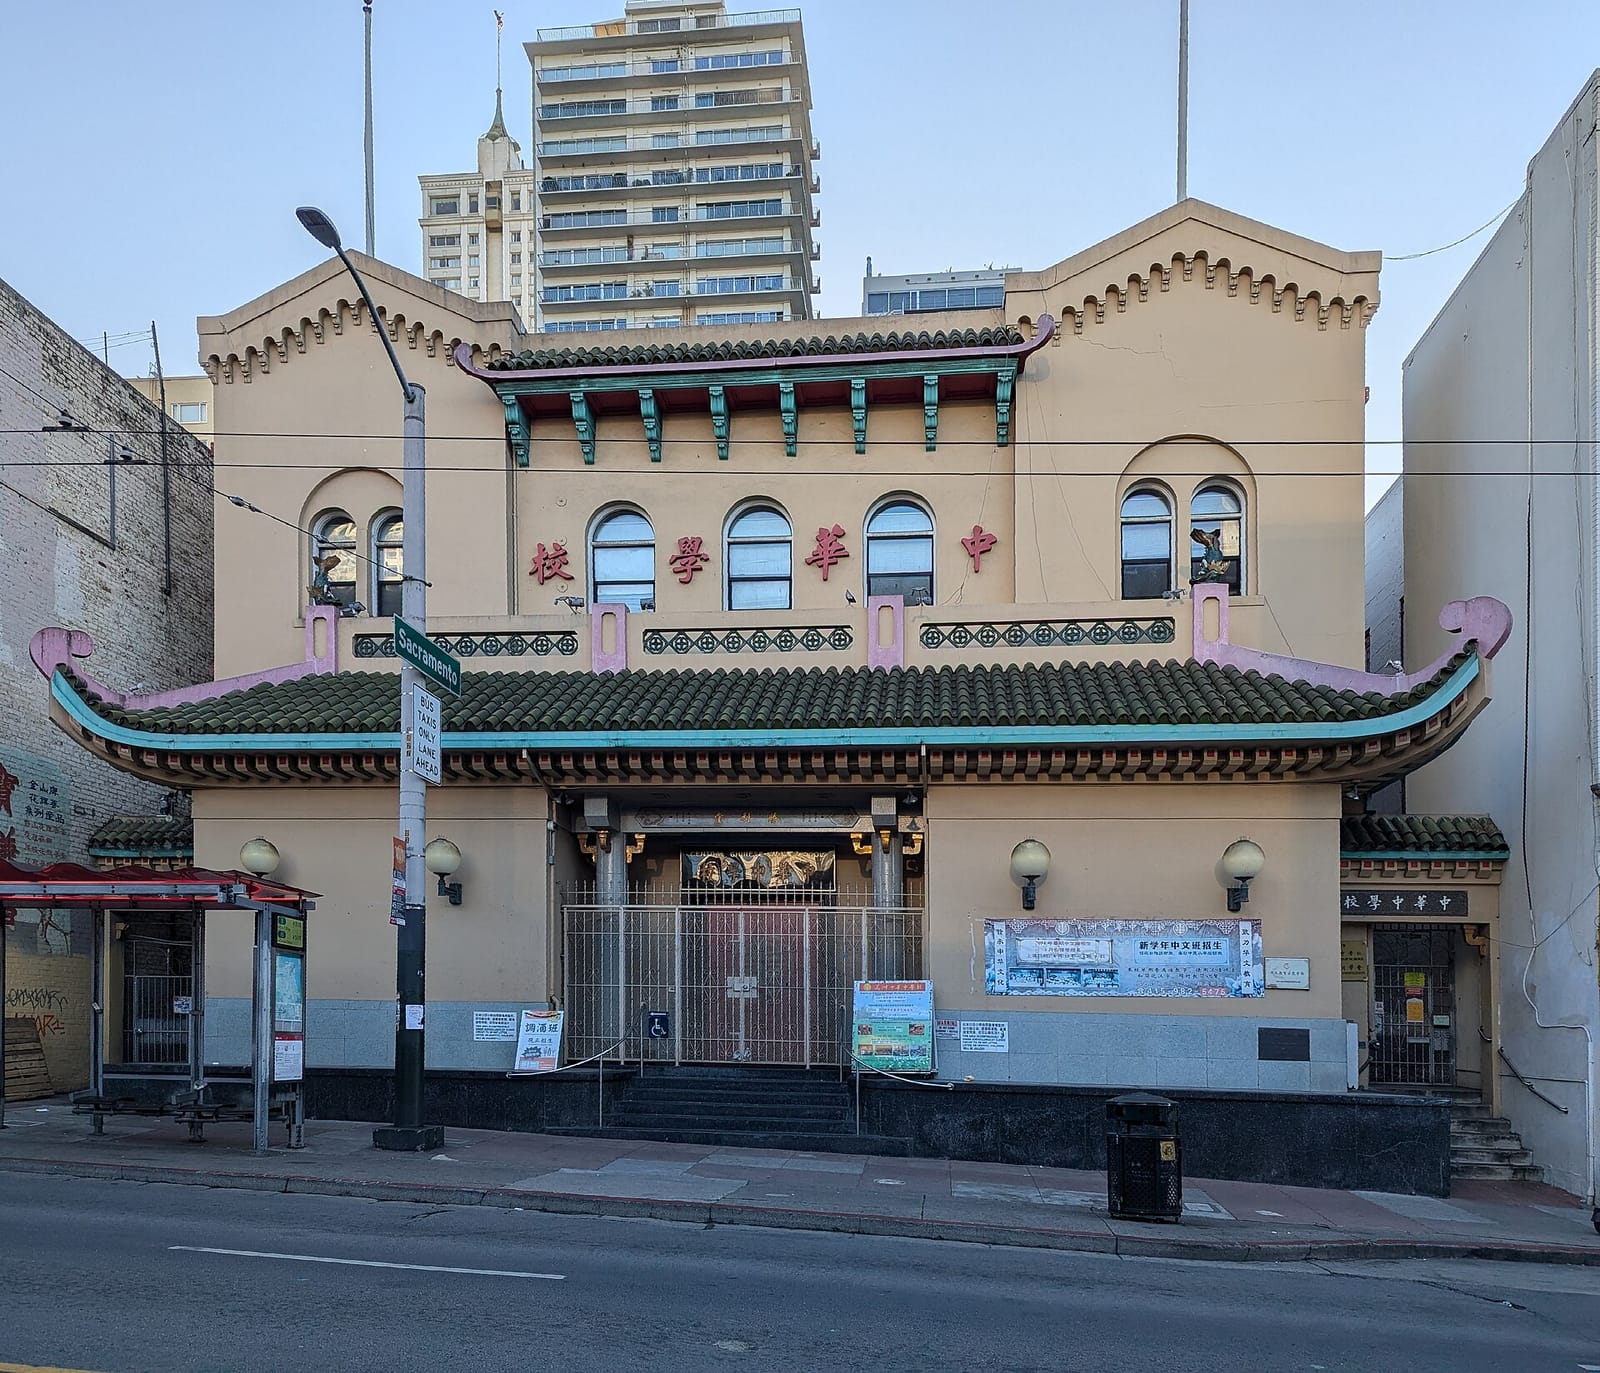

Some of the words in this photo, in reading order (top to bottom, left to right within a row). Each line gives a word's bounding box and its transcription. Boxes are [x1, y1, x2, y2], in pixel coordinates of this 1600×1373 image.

[398, 628, 458, 686] Sacramento
[420, 696, 434, 713] BUS
[417, 709, 437, 730] TAXIS
[418, 726, 436, 745] ONLY
[418, 742, 436, 760] LANE
[415, 757, 439, 776] AHEAD
[1139, 940, 1222, 950] 新学年中文班招生
